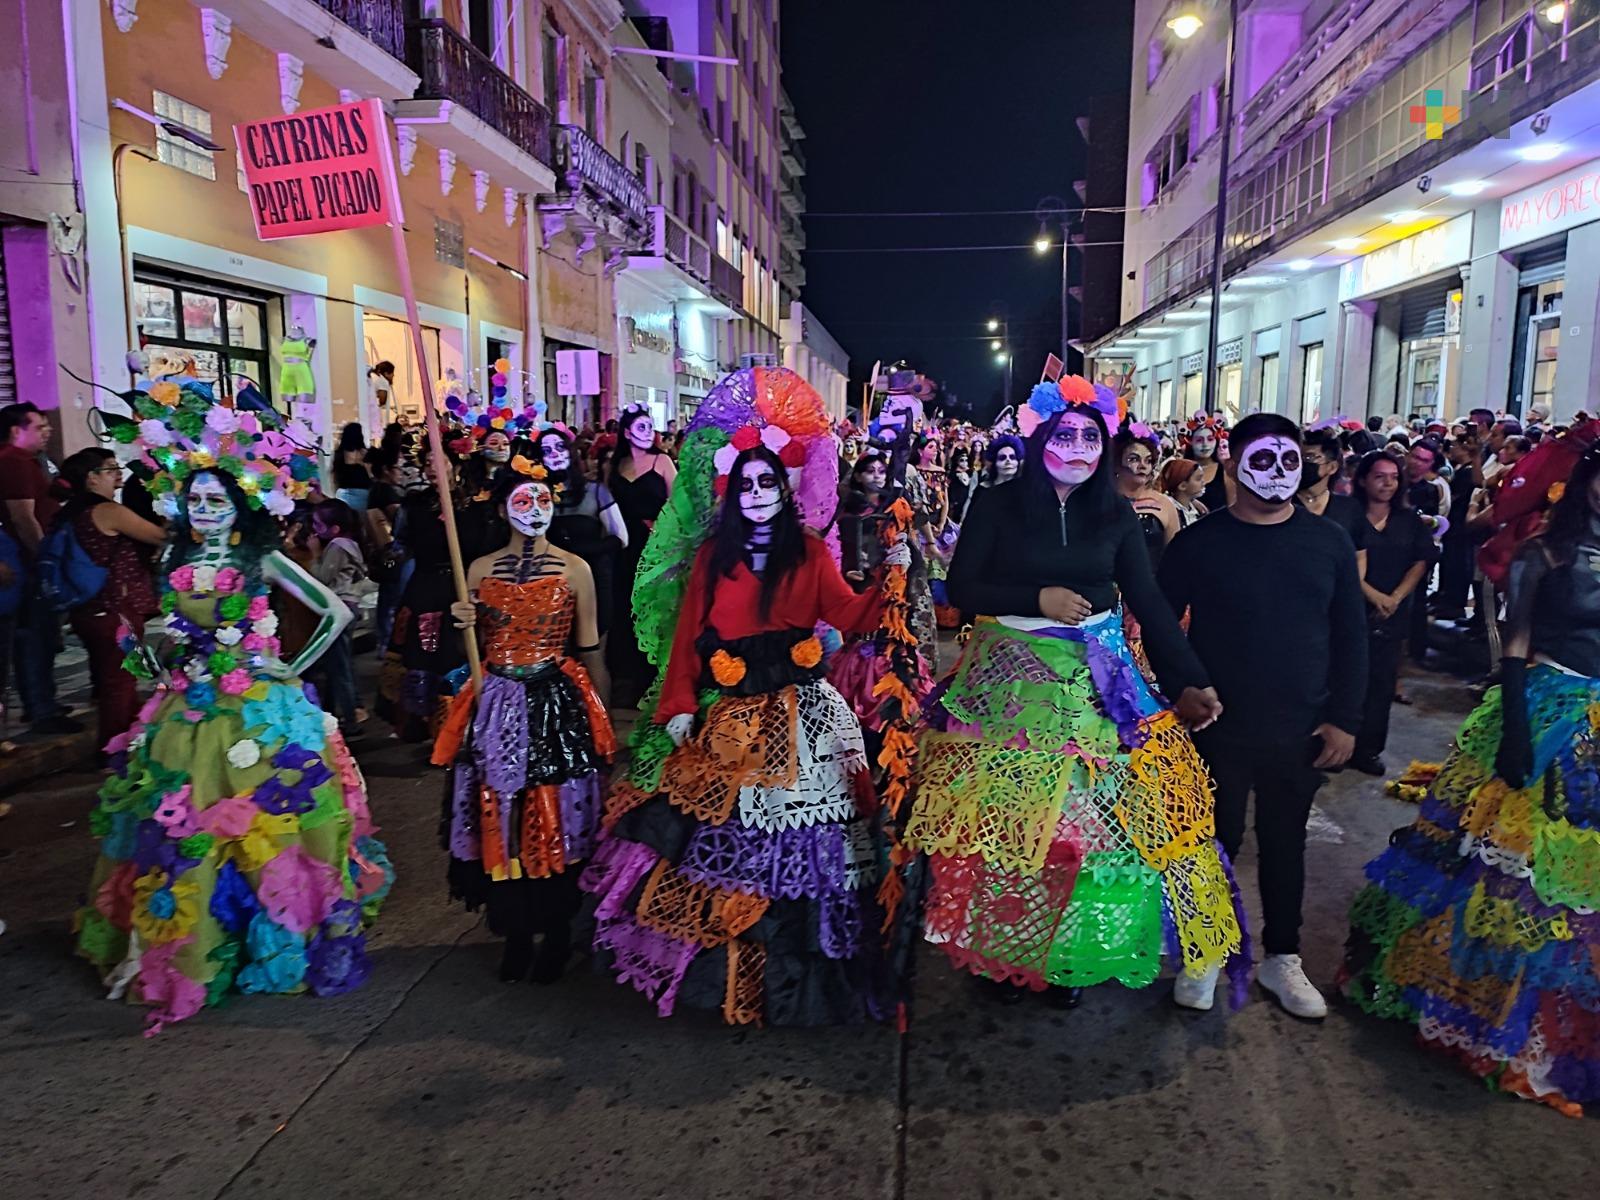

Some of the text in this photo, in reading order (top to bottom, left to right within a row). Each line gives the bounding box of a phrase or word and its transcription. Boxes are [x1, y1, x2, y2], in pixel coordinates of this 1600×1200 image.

[246, 108, 367, 169] CATRINAS
[252, 168, 381, 226] PAPEL PICADO
